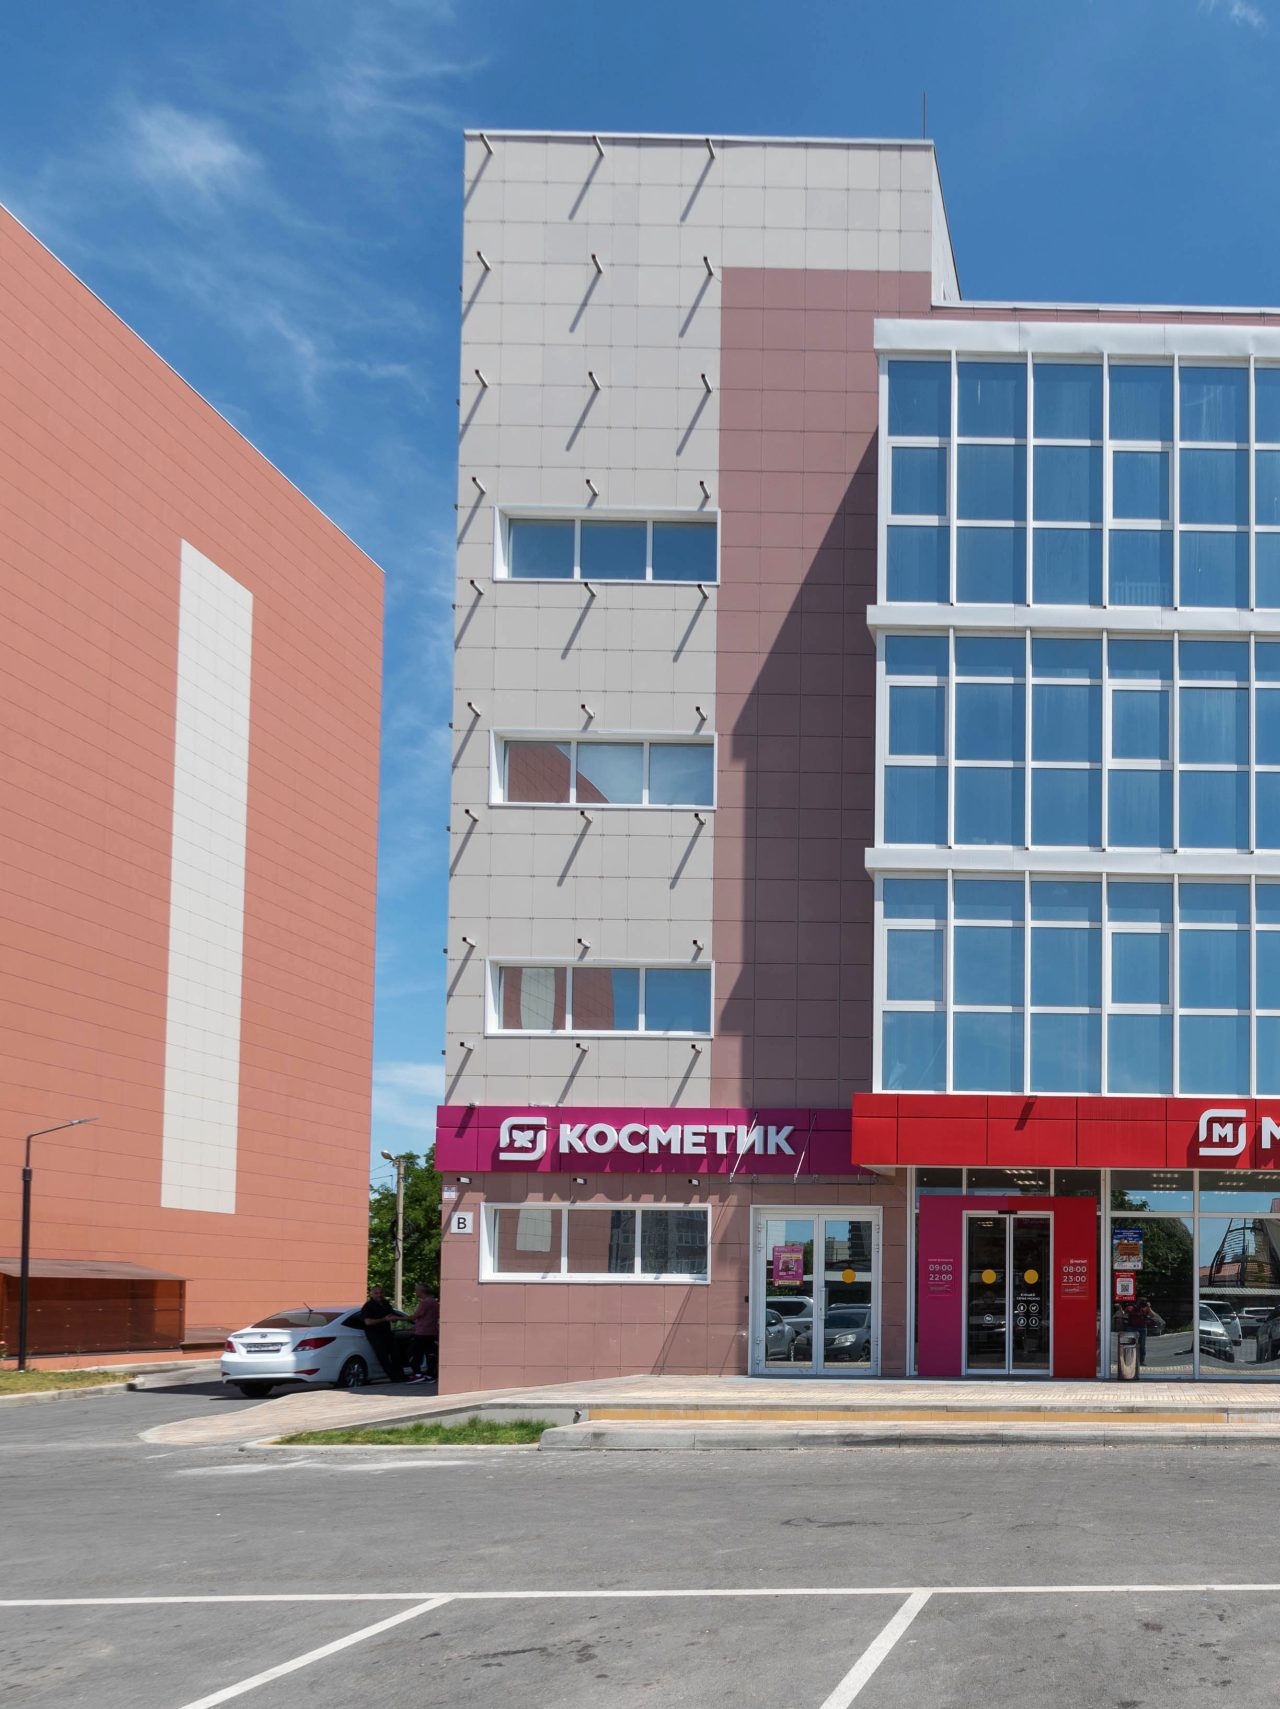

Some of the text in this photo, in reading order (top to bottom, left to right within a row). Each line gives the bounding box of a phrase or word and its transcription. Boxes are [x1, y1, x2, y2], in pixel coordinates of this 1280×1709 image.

[559, 1123, 796, 1155] КОСМЕТИК
[1062, 1265, 1087, 1273] 08:00
[929, 1273, 953, 1281] 22:00
[1063, 1275, 1087, 1283] 23:00
